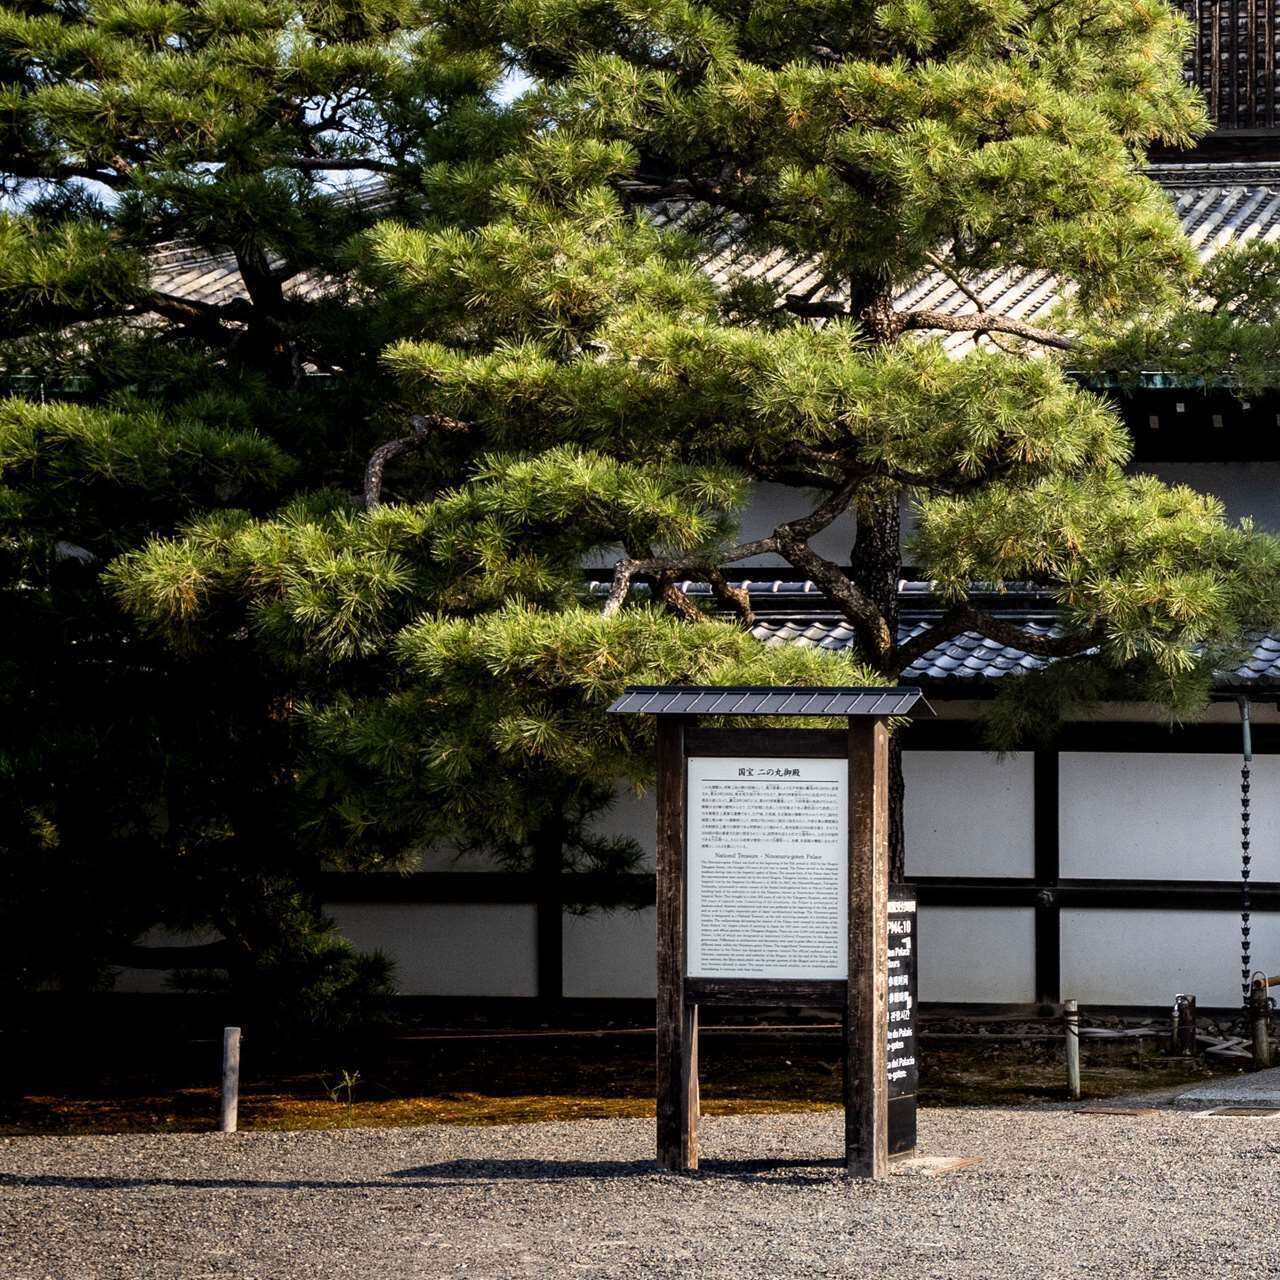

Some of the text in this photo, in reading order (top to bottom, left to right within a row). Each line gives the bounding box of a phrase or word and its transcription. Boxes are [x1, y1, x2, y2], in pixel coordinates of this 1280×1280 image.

[738, 767, 801, 777] 国宝 二の丸御殿
